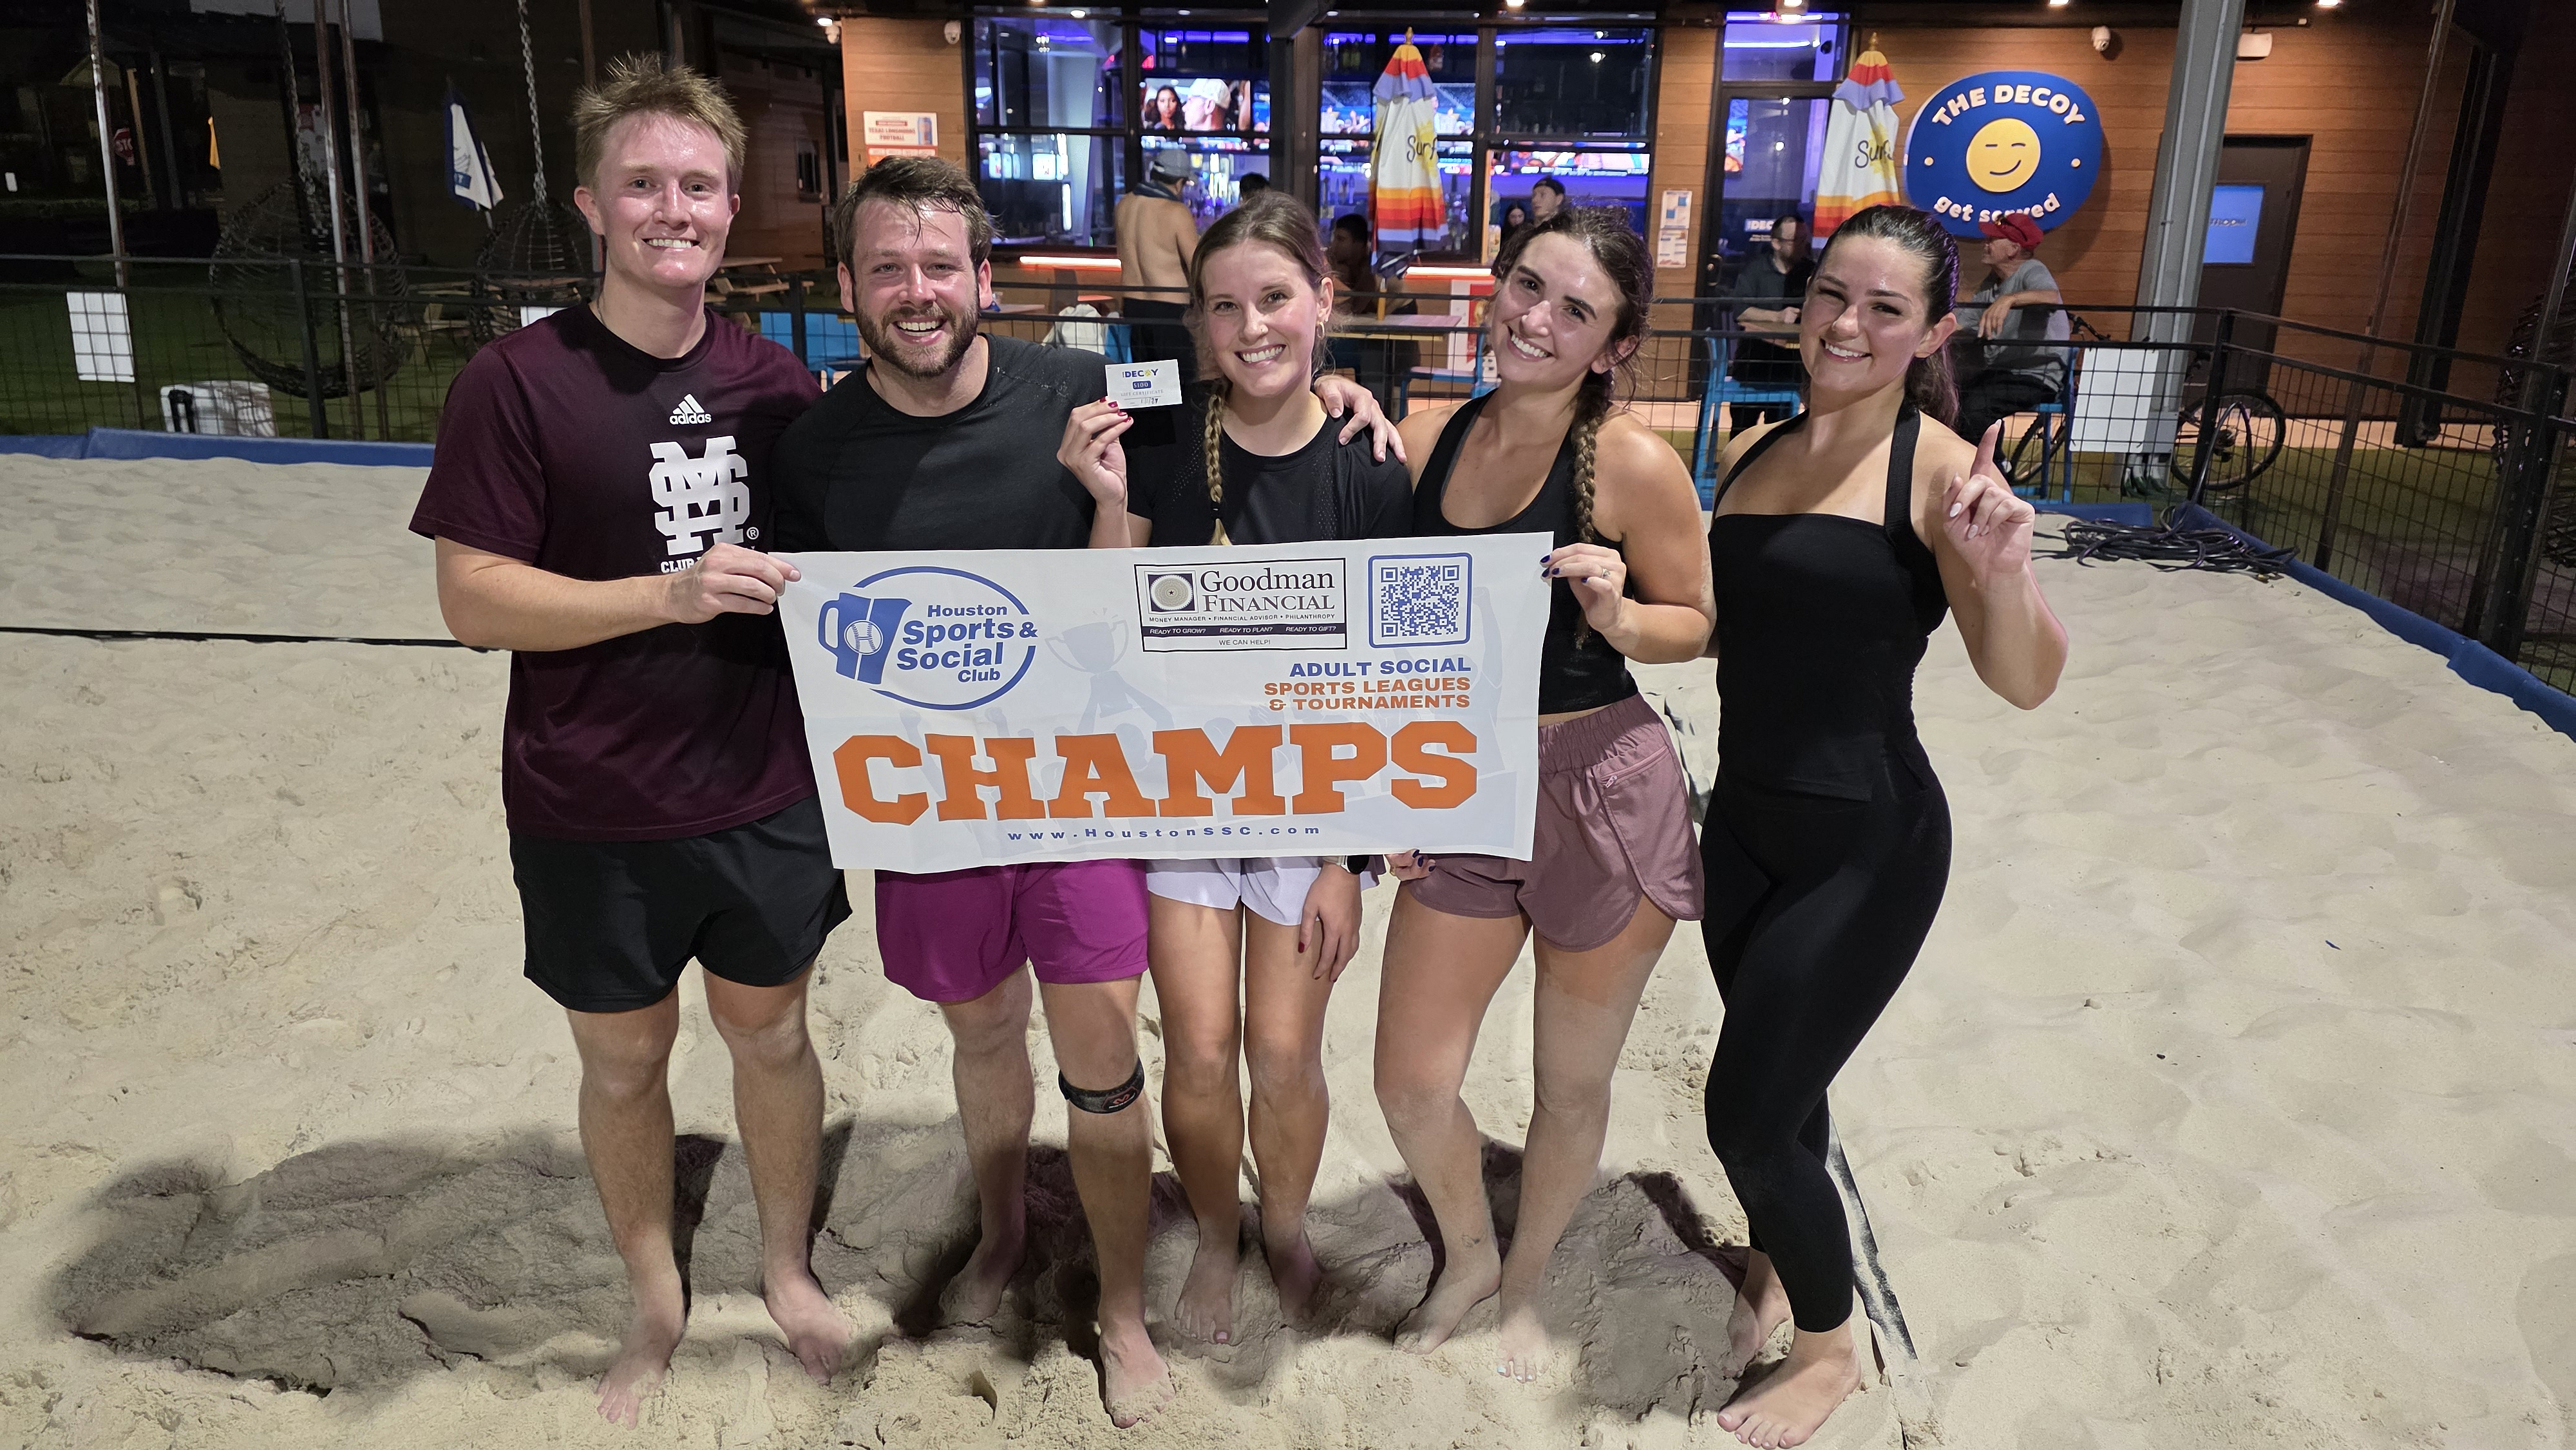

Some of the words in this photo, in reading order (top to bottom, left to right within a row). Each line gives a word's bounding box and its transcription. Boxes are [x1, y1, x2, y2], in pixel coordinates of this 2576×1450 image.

[1932, 87, 1987, 126] THE
[1994, 84, 2086, 125] DECOY
[1406, 135, 1437, 162] Surf
[1933, 196, 1974, 221] get
[669, 412, 712, 425] adidas
[1200, 567, 1335, 592] Goodman
[927, 605, 1008, 617] Houston
[1202, 595, 1335, 612] FINANCIAL
[902, 619, 1014, 648] Sports
[1019, 622, 1038, 637] &
[896, 642, 1003, 670] Social
[958, 668, 1001, 683] Club
[1289, 662, 1372, 677] ADULT
[1380, 657, 1472, 675] SOCIAL
[1264, 681, 1356, 696] SPORTS
[1363, 677, 1471, 693] LEAGUES
[1269, 699, 1287, 711] &
[1293, 694, 1471, 711] TOURNAMENTS
[833, 720, 1477, 826] CHAMPS
[1008, 826, 1321, 841] www.HoustonSSC.com
